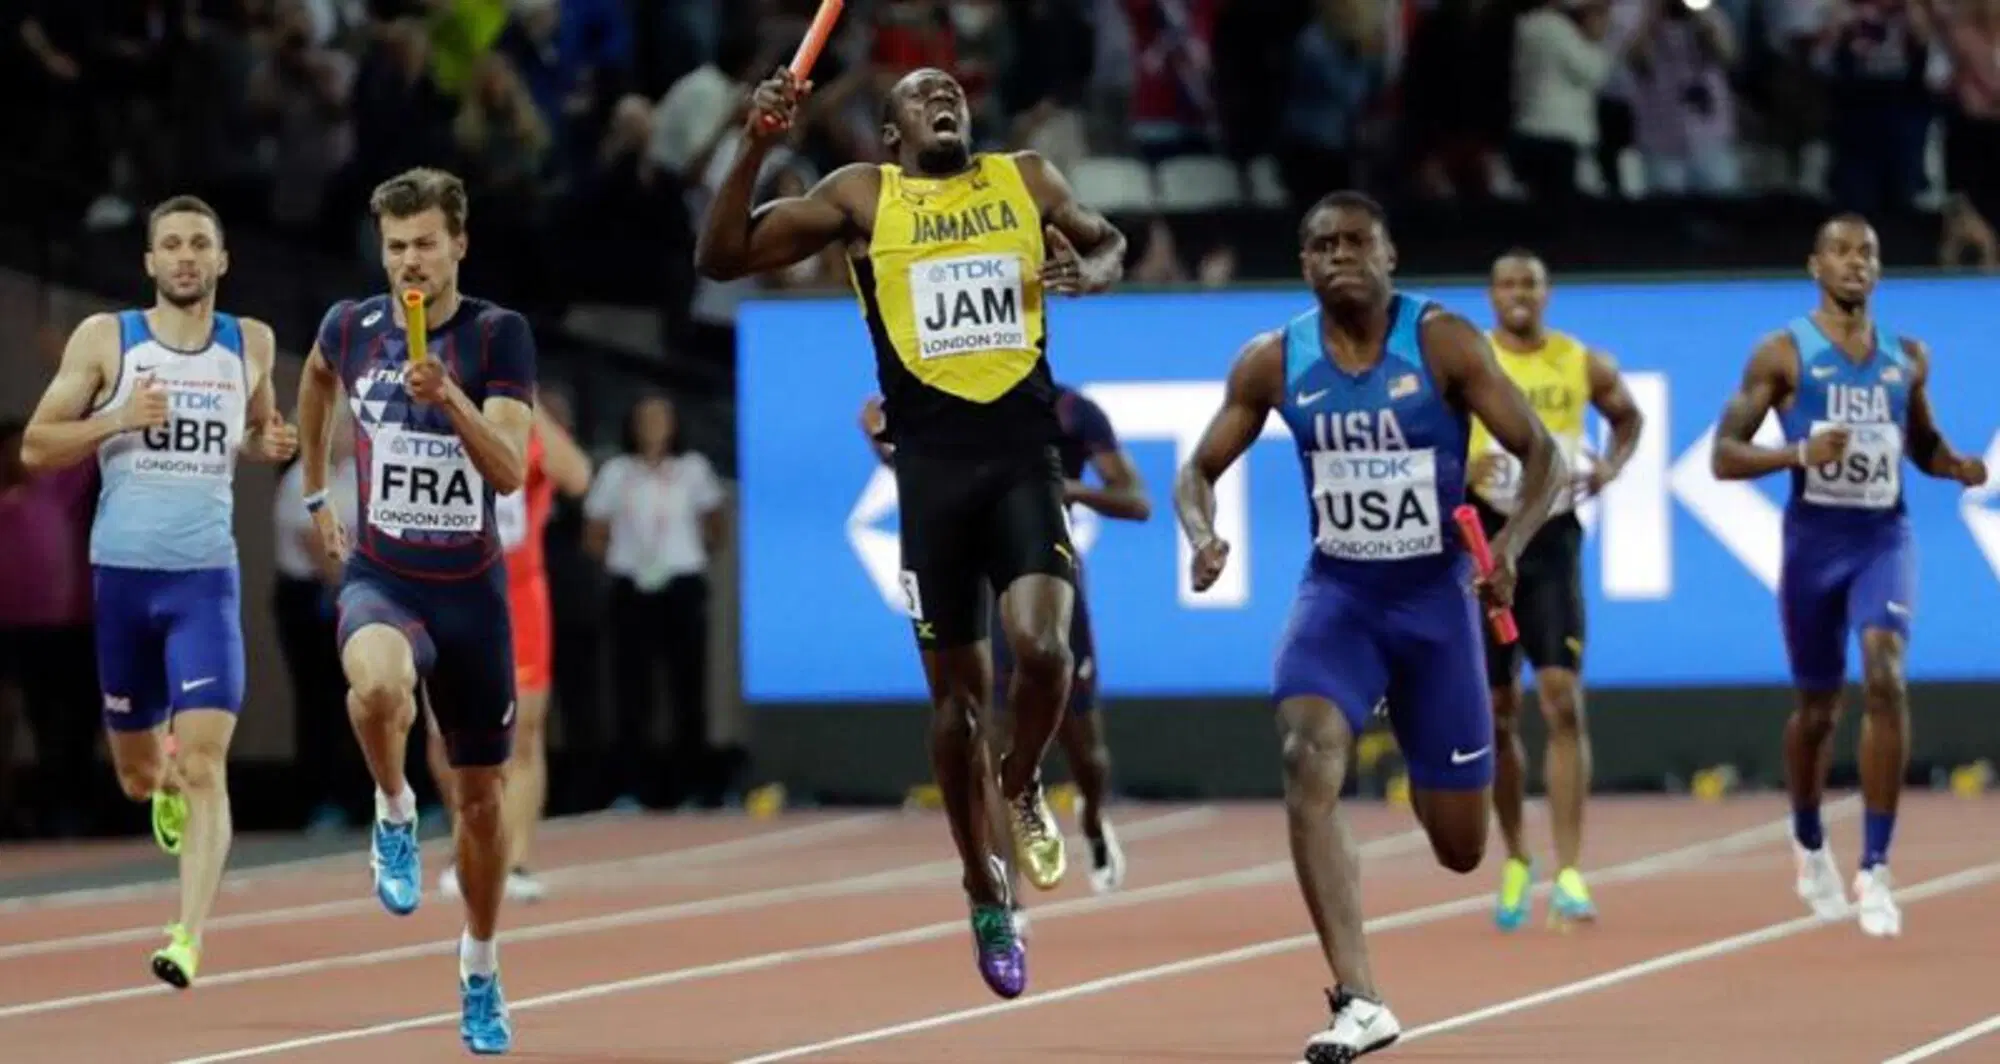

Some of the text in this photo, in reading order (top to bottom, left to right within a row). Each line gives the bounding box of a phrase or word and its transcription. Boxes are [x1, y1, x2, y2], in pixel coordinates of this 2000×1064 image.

[911, 200, 1019, 244] JAMAICA
[946, 259, 1005, 281] TDK
[924, 286, 1017, 331] JAM
[923, 334, 991, 354] LONDON
[171, 391, 223, 411] TDK
[1827, 383, 1891, 422] USA
[143, 416, 228, 455] GBR
[1314, 408, 1410, 451] USA
[407, 437, 466, 460] TDK
[381, 462, 474, 506] FRA
[1347, 456, 1412, 480] TDK
[1820, 452, 1890, 484] USA
[374, 507, 477, 526] LONDON 2017
[1324, 485, 1430, 532] USA
